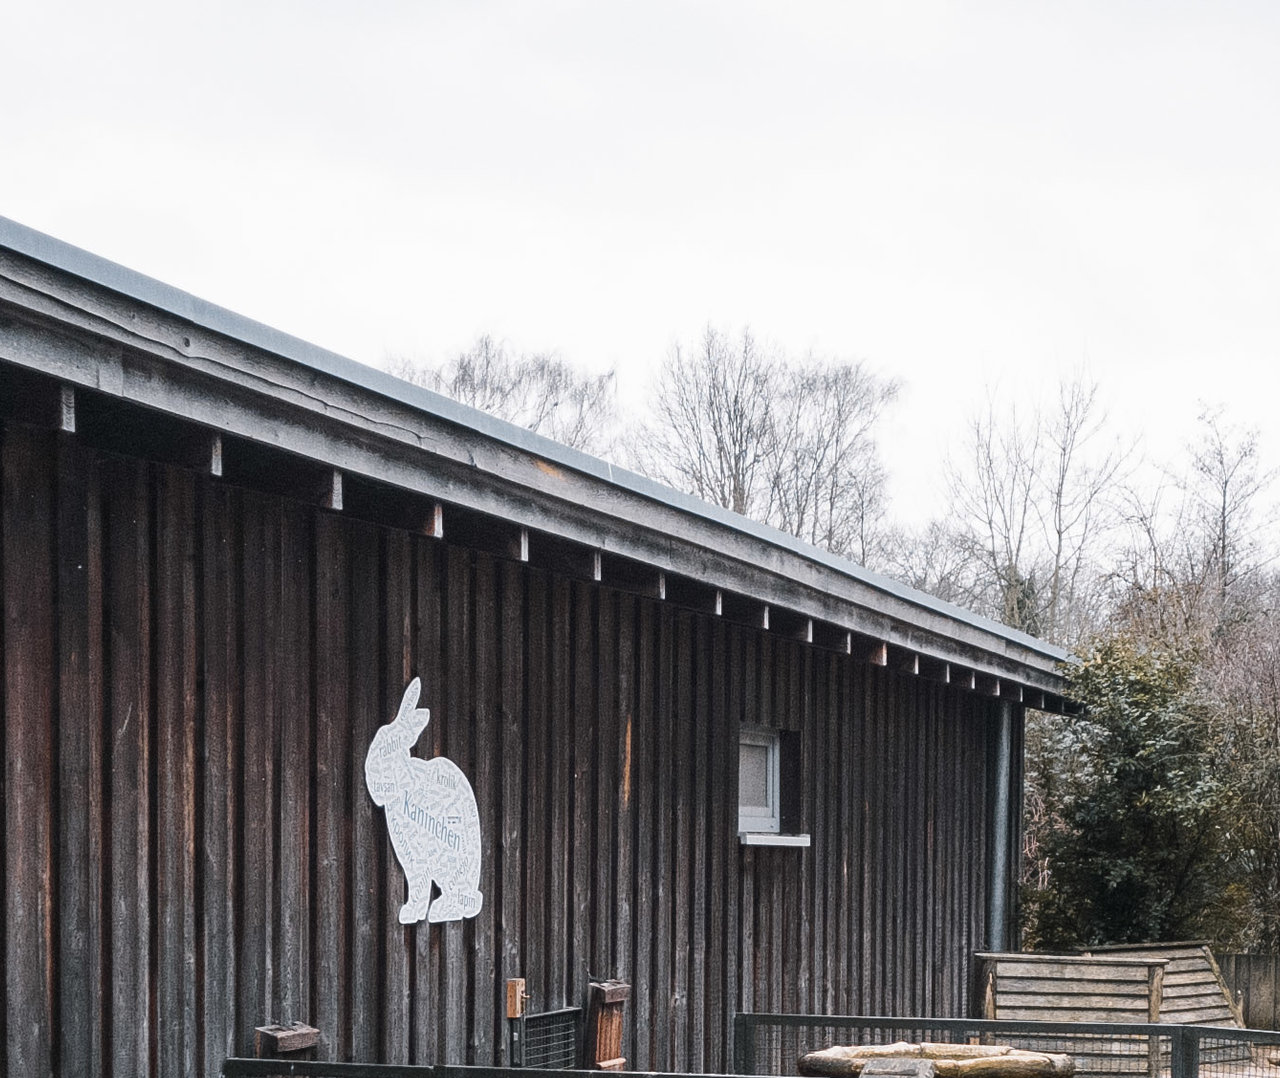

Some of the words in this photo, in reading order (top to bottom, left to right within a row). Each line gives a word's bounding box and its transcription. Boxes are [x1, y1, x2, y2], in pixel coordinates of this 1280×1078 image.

[379, 734, 402, 758] rabbit
[403, 789, 461, 852] Kaninchen
[457, 887, 477, 911] lapin
